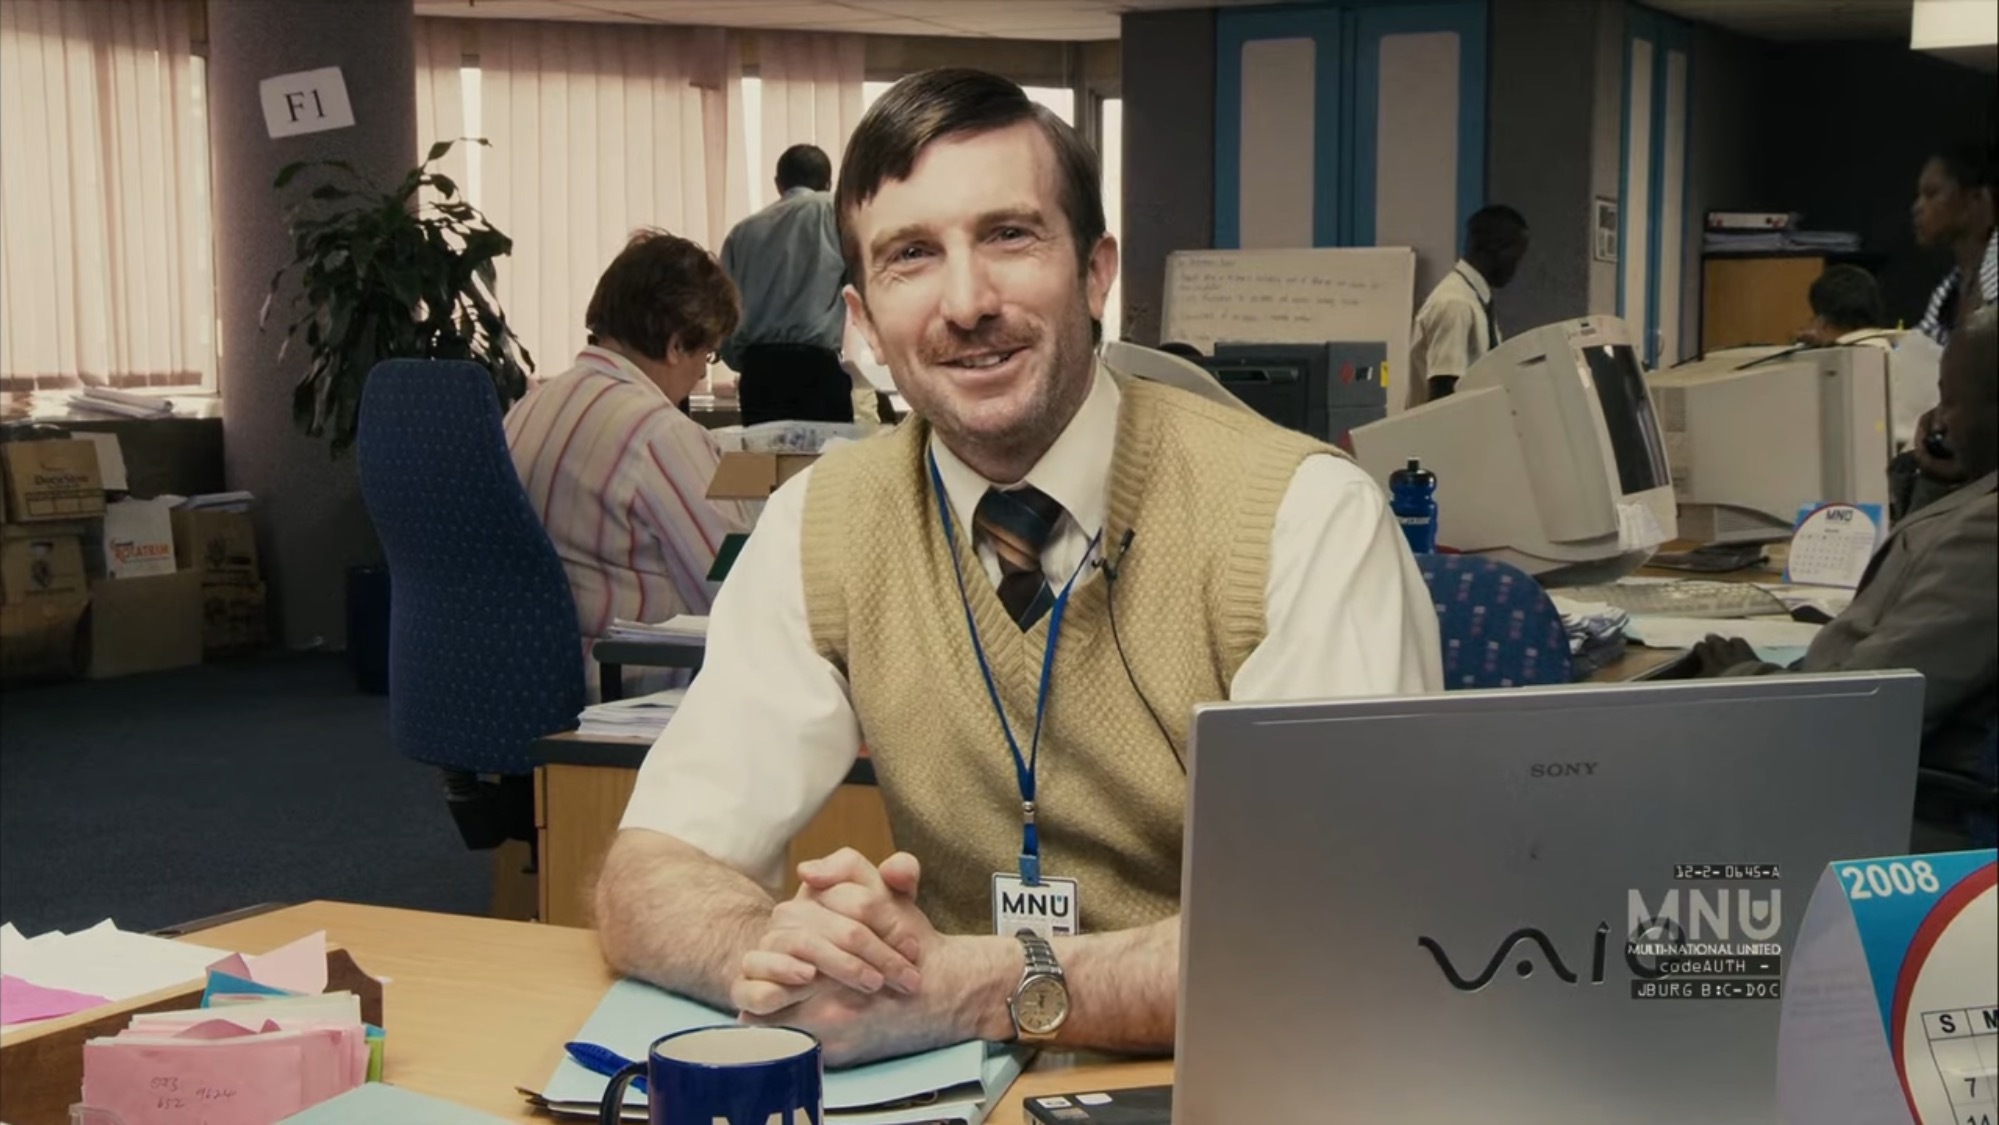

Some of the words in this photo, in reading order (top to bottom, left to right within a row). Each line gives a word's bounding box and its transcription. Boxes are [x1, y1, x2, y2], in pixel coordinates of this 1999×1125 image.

[284, 89, 326, 122] F1
[1531, 762, 1599, 777] SONY
[1842, 860, 1940, 900] 2008
[1002, 891, 1068, 917] MNU
[1418, 916, 1686, 991] VAIO
[1939, 1014, 1956, 1033] S
[1964, 1077, 1976, 1098] 7
